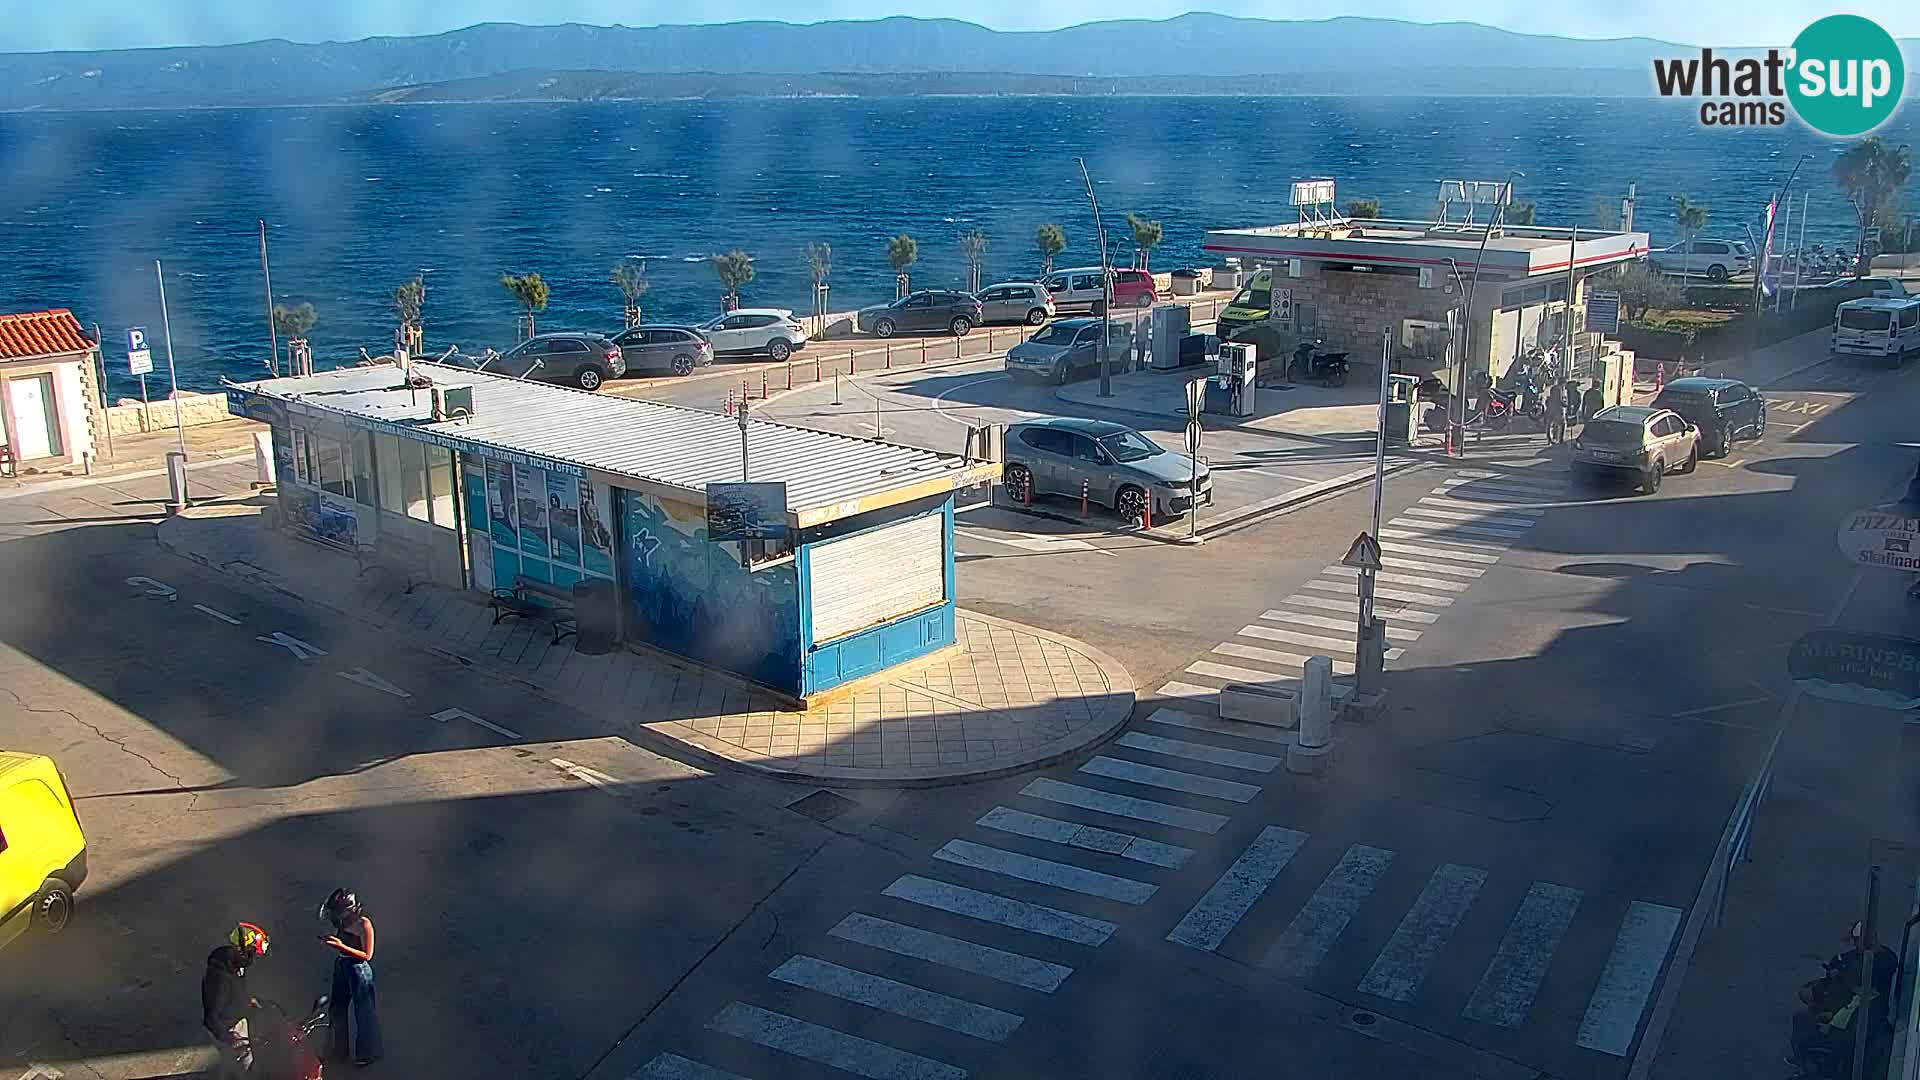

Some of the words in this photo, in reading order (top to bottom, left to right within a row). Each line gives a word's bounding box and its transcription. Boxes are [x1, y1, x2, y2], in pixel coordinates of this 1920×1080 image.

[130, 330, 144, 350] P
[437, 437, 469, 451] POSTAJA
[479, 445, 494, 457] BUS
[495, 449, 527, 465] STATION
[529, 457, 555, 471] TICKET
[556, 461, 583, 477] OFFICE
[1848, 515, 1920, 533] PIZZE
